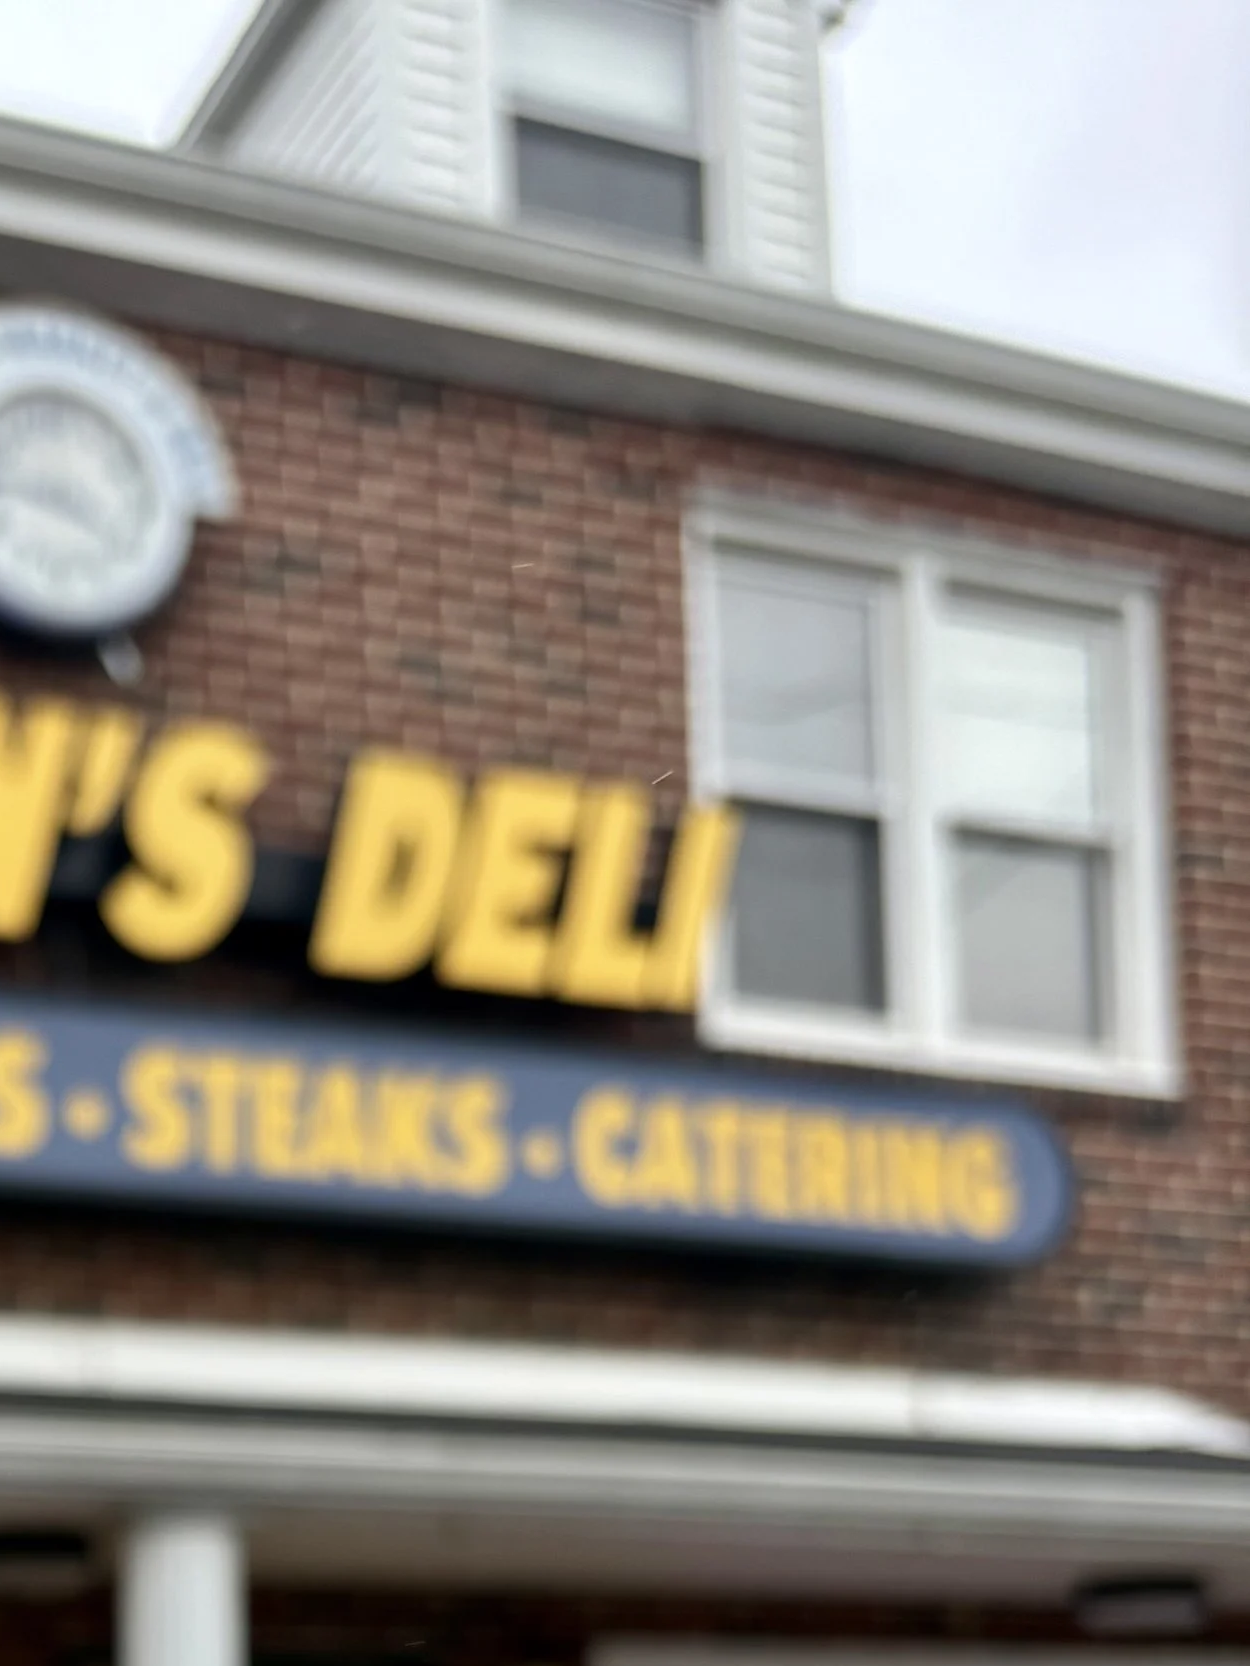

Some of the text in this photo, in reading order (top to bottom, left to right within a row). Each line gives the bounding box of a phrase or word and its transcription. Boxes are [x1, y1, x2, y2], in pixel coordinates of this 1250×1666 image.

[310, 744, 740, 1014] DELI
[122, 1044, 511, 1197] STEAKS
[572, 1085, 1018, 1242] CATERING
